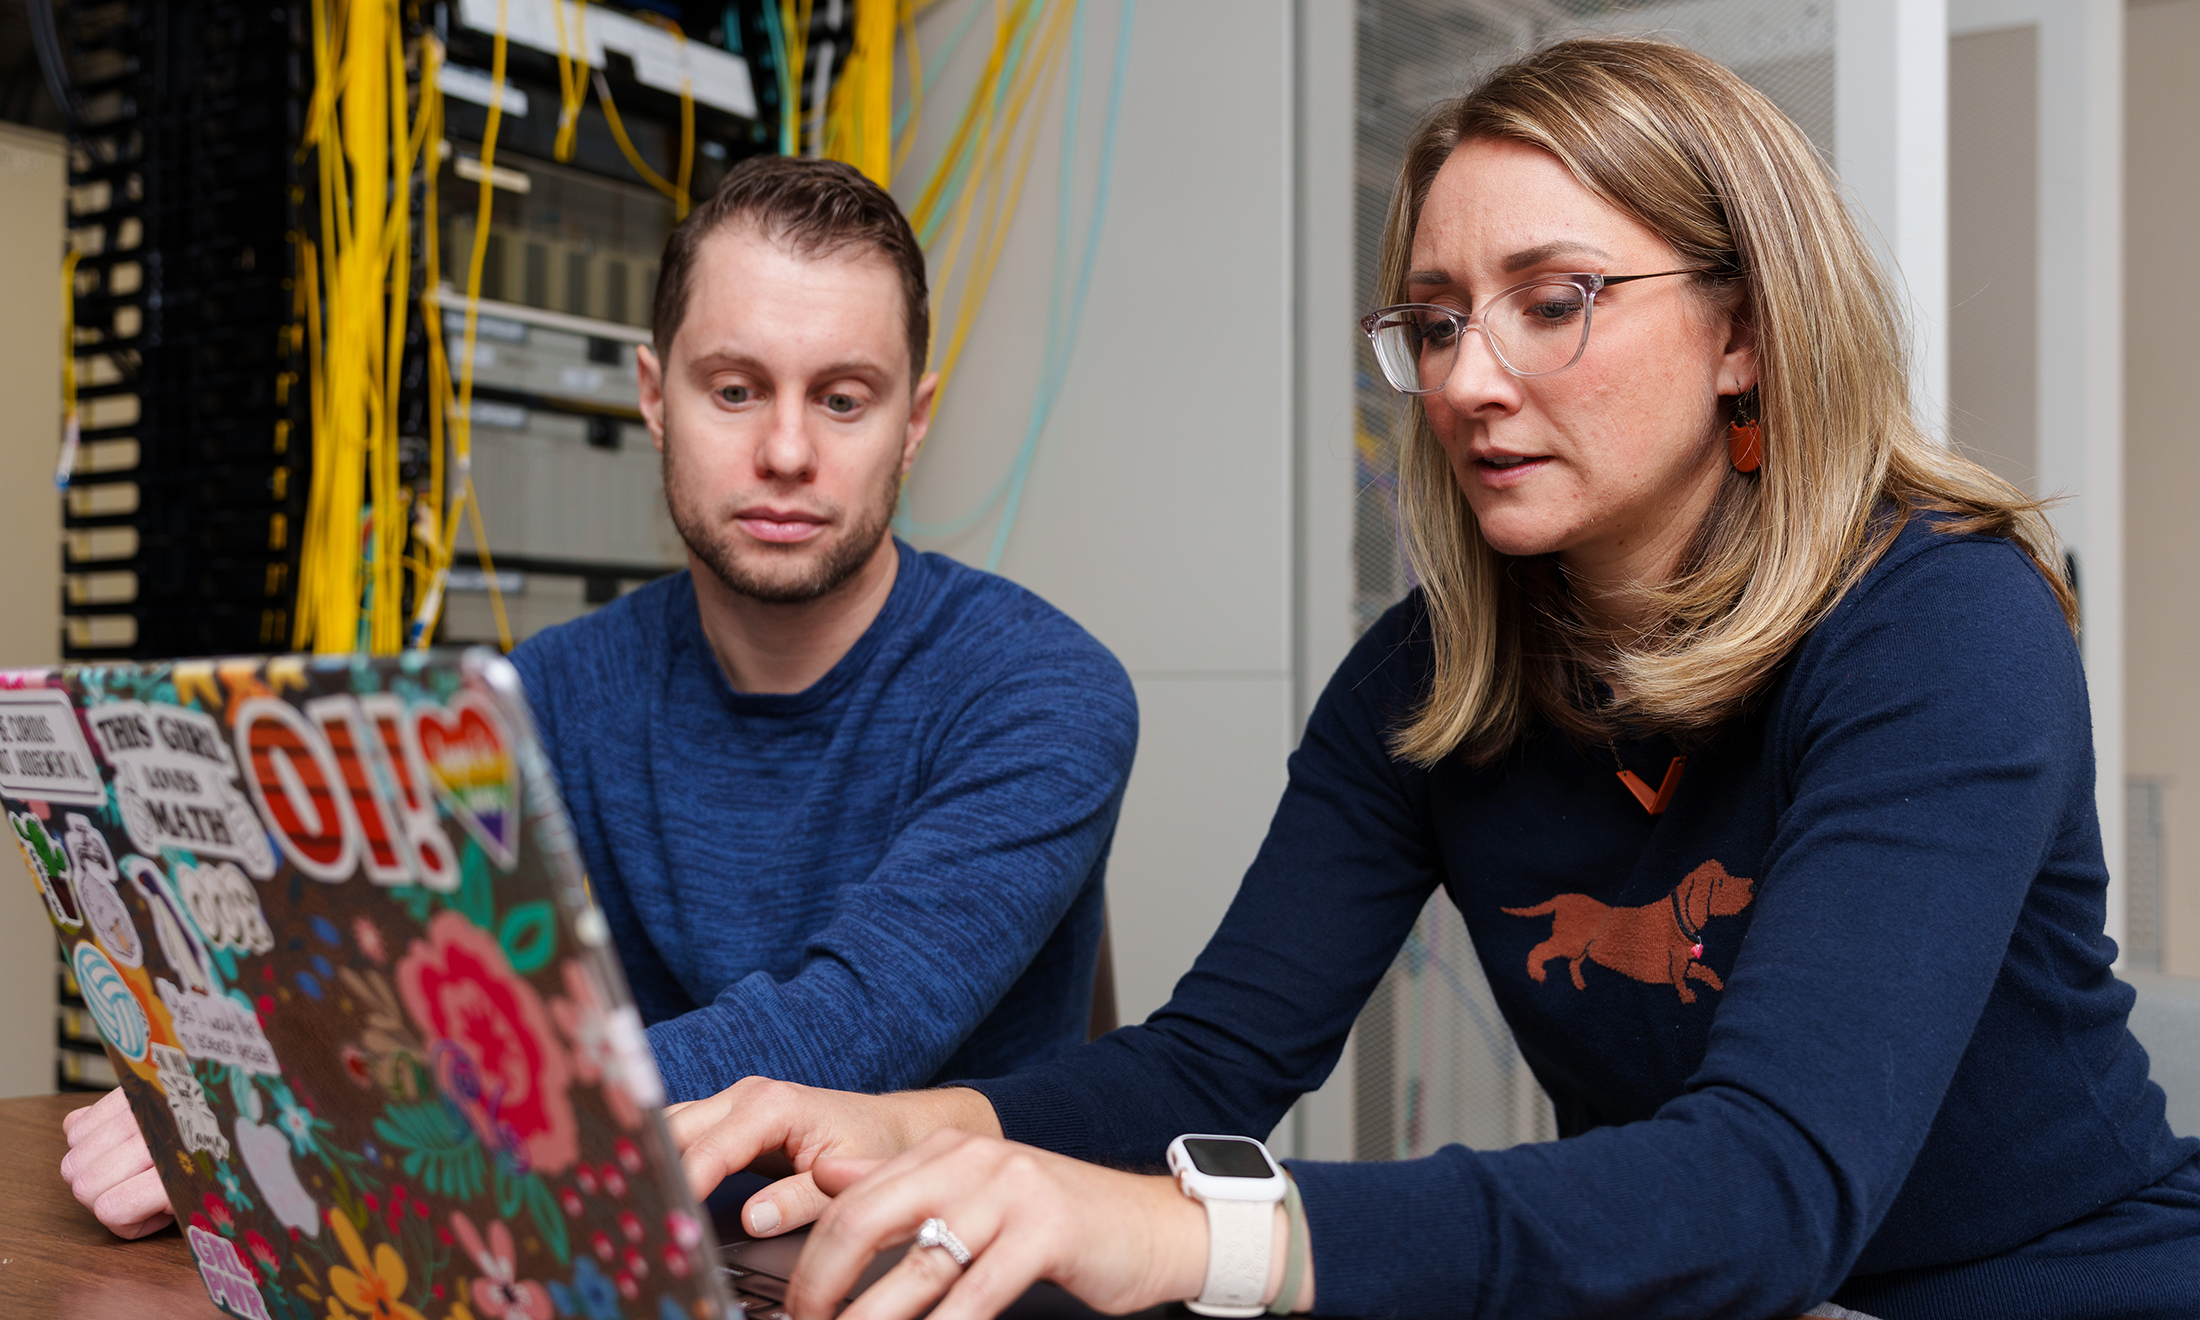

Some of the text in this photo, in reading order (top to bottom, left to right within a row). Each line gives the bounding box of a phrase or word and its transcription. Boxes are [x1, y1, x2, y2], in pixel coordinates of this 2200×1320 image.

[7, 714, 55, 743] CURIOUS
[97, 714, 227, 764] THIS GIRL
[0, 749, 17, 776] OT
[143, 766, 203, 795] LOVES
[146, 799, 233, 845] MATH
[190, 1229, 250, 1281] GRL
[201, 1264, 270, 1320] PWR
